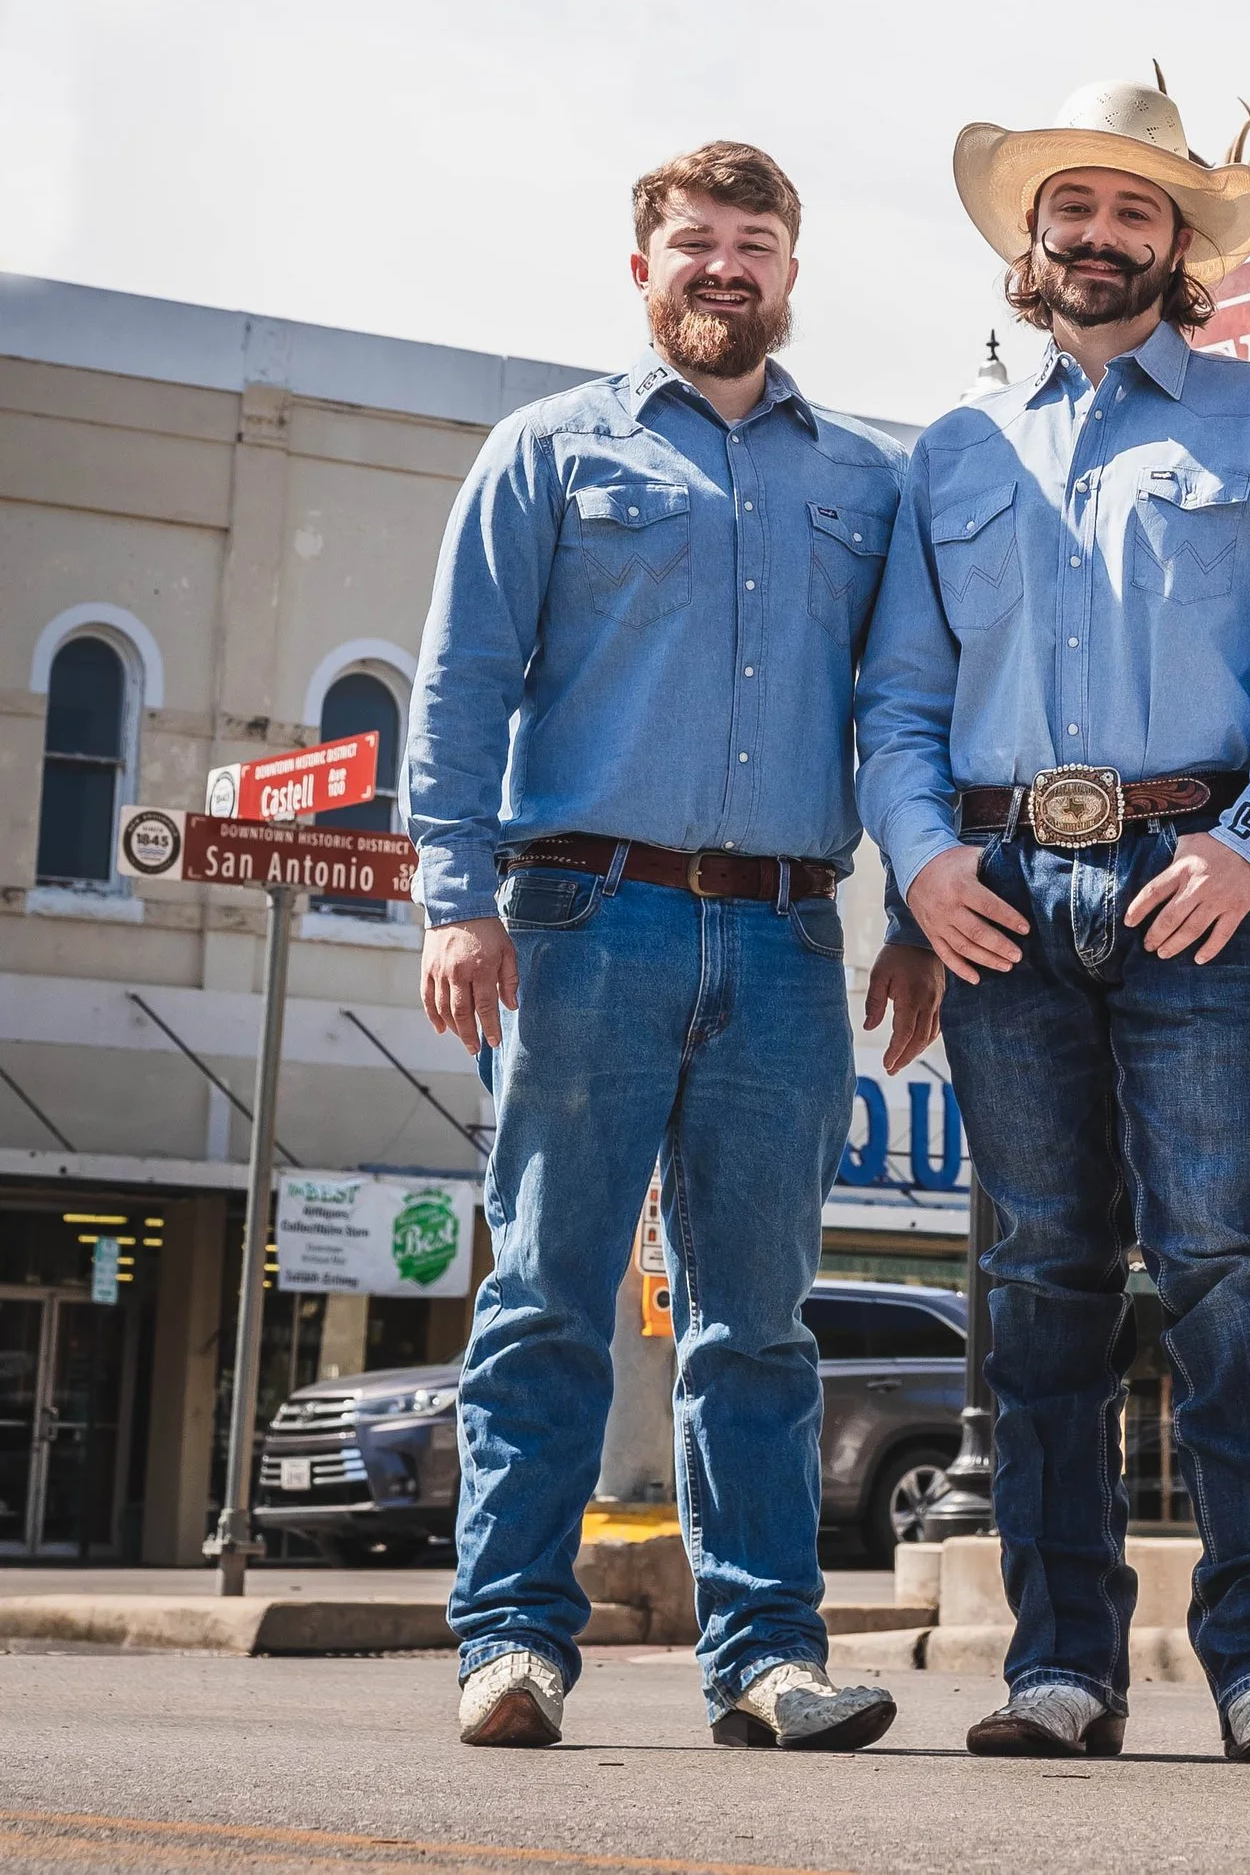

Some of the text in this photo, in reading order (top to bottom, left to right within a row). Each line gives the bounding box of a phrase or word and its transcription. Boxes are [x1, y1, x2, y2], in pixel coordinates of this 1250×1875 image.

[328, 768, 347, 782] Ave
[261, 773, 315, 817] Castell
[136, 833, 169, 848] 1845
[220, 823, 410, 856] DOWNTOWN HISTORIC DISTRICT
[204, 845, 374, 892] San Antonio
[391, 876, 410, 893] 10
